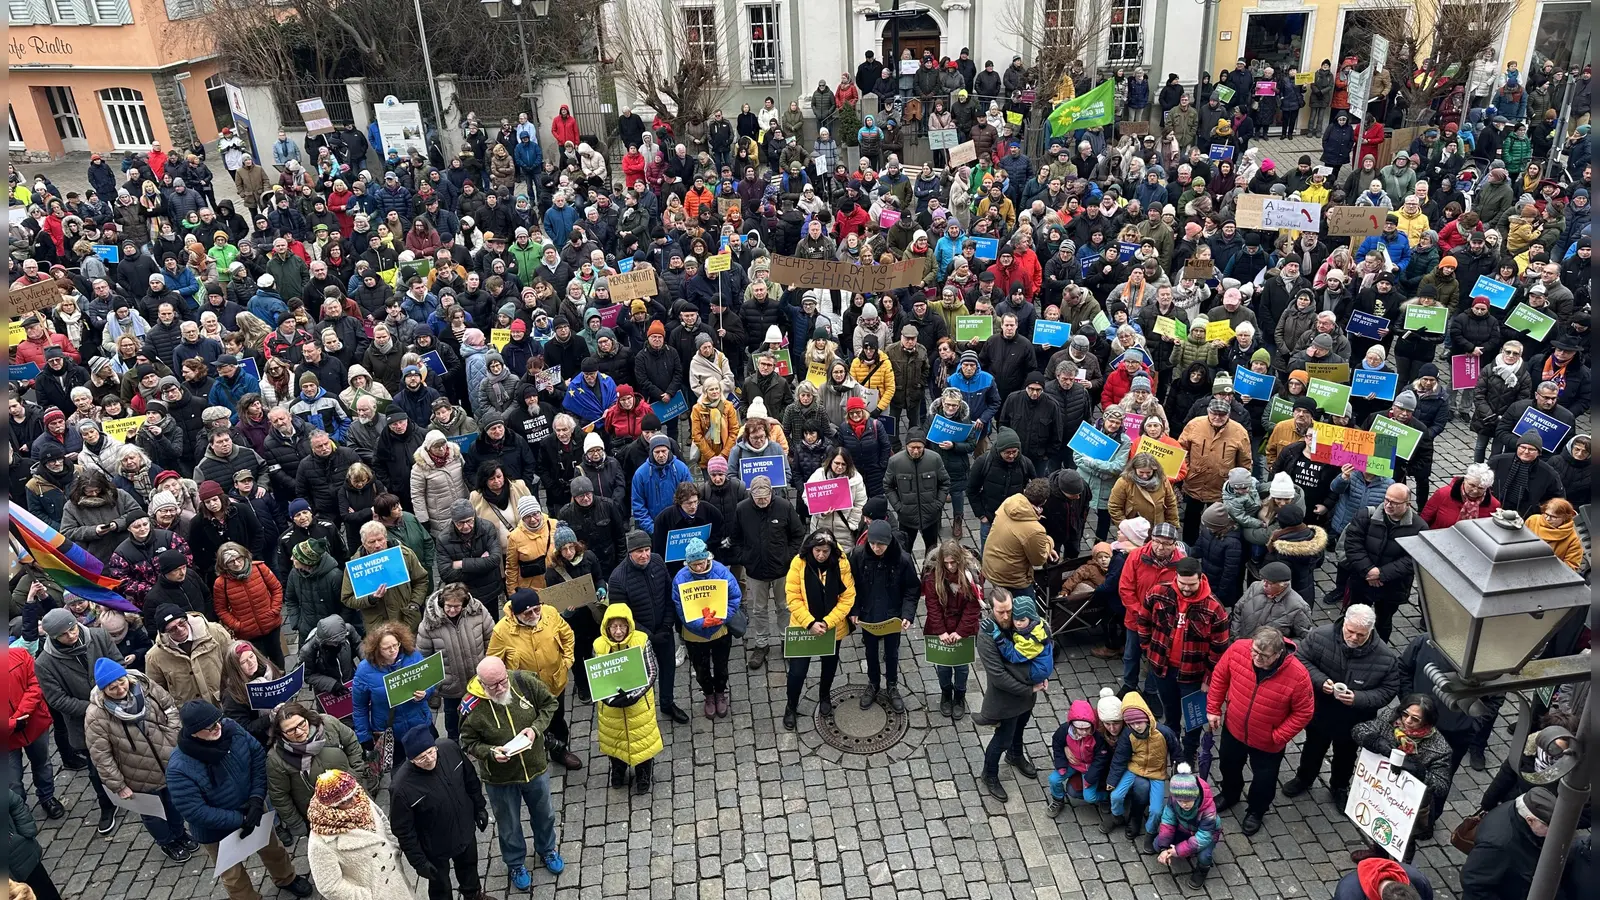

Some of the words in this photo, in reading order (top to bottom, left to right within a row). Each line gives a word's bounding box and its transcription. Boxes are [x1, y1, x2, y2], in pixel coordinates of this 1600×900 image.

[9, 37, 27, 59] afe
[28, 36, 73, 54] Rialto
[1265, 202, 1274, 211] A
[1276, 204, 1295, 213] bgrund
[1336, 209, 1344, 217] A
[1347, 209, 1365, 218] bgrund
[1275, 219, 1301, 228] eutschland
[1332, 226, 1339, 234] D
[772, 256, 814, 271] RECHTS
[822, 261, 842, 273] IST
[850, 264, 866, 277] DA
[871, 265, 888, 274] WO
[893, 260, 915, 272] KEIN
[609, 270, 652, 286] MENSCHENRECHTE
[800, 272, 864, 293] GEHIRN
[872, 276, 897, 291] IST
[22, 286, 54, 300] Wieder
[1487, 283, 1505, 291] WIEDER
[16, 304, 27, 314] ist
[1359, 319, 1372, 327] JETZT.
[1362, 316, 1379, 324] WIEDER
[1245, 373, 1263, 382] WIEDER
[1320, 385, 1338, 393] WIEDER
[524, 418, 547, 430] RECHTE
[1524, 412, 1538, 420] NIE
[1537, 417, 1558, 430] WIEDER
[1532, 421, 1548, 432] JETZT.
[942, 427, 956, 435] JETZT.
[945, 423, 963, 432] WIEDER
[1387, 423, 1408, 436] WIEDER
[526, 428, 549, 440] RECHTE
[1082, 426, 1091, 434] NIE
[1090, 432, 1107, 446] WIEDER
[1315, 424, 1393, 446] MENSCHENRECHTE
[1141, 445, 1149, 453] IST
[1149, 448, 1165, 458] JETZT.
[1143, 440, 1153, 448] NIE
[1153, 445, 1174, 456] WIEDER
[1333, 439, 1362, 454] STATT
[1316, 451, 1342, 461] rechte
[1348, 454, 1385, 471] Menschen
[1296, 474, 1319, 483] HUMAN
[817, 483, 838, 491] WIEDER
[351, 564, 363, 572] NIE
[363, 556, 390, 568] WIEDER
[353, 571, 363, 579] IST
[363, 566, 384, 576] JETZT.
[694, 584, 717, 592] WIEDER
[693, 592, 711, 600] JETZT.
[603, 656, 629, 667] WIEDER
[389, 675, 401, 684] NIE
[401, 663, 429, 678] WIEDER
[602, 667, 623, 677] JETZT.
[267, 677, 293, 691] WIEDER
[389, 682, 401, 690] IST
[401, 674, 423, 684] JETZT.
[264, 688, 287, 697] JETZT.
[1391, 835, 1404, 848] EU
